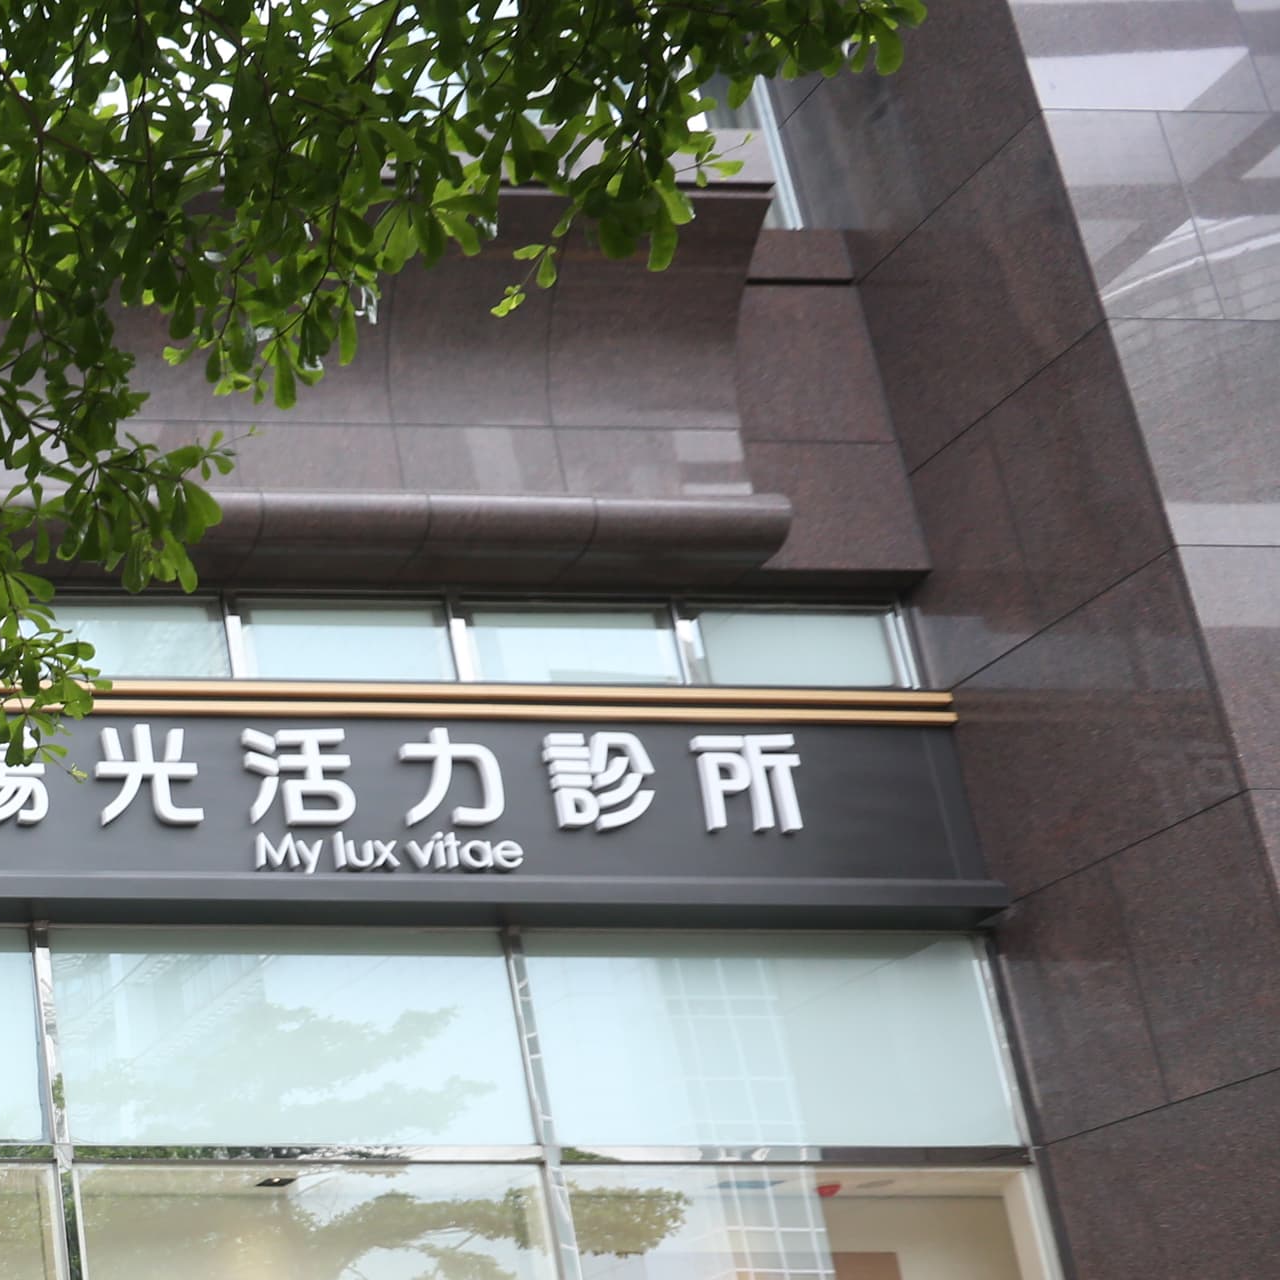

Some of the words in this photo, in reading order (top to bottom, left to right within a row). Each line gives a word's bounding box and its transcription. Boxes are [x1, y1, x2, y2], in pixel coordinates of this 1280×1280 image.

[255, 831, 324, 875] My
[332, 831, 401, 871] lux
[405, 831, 525, 871] vitae
